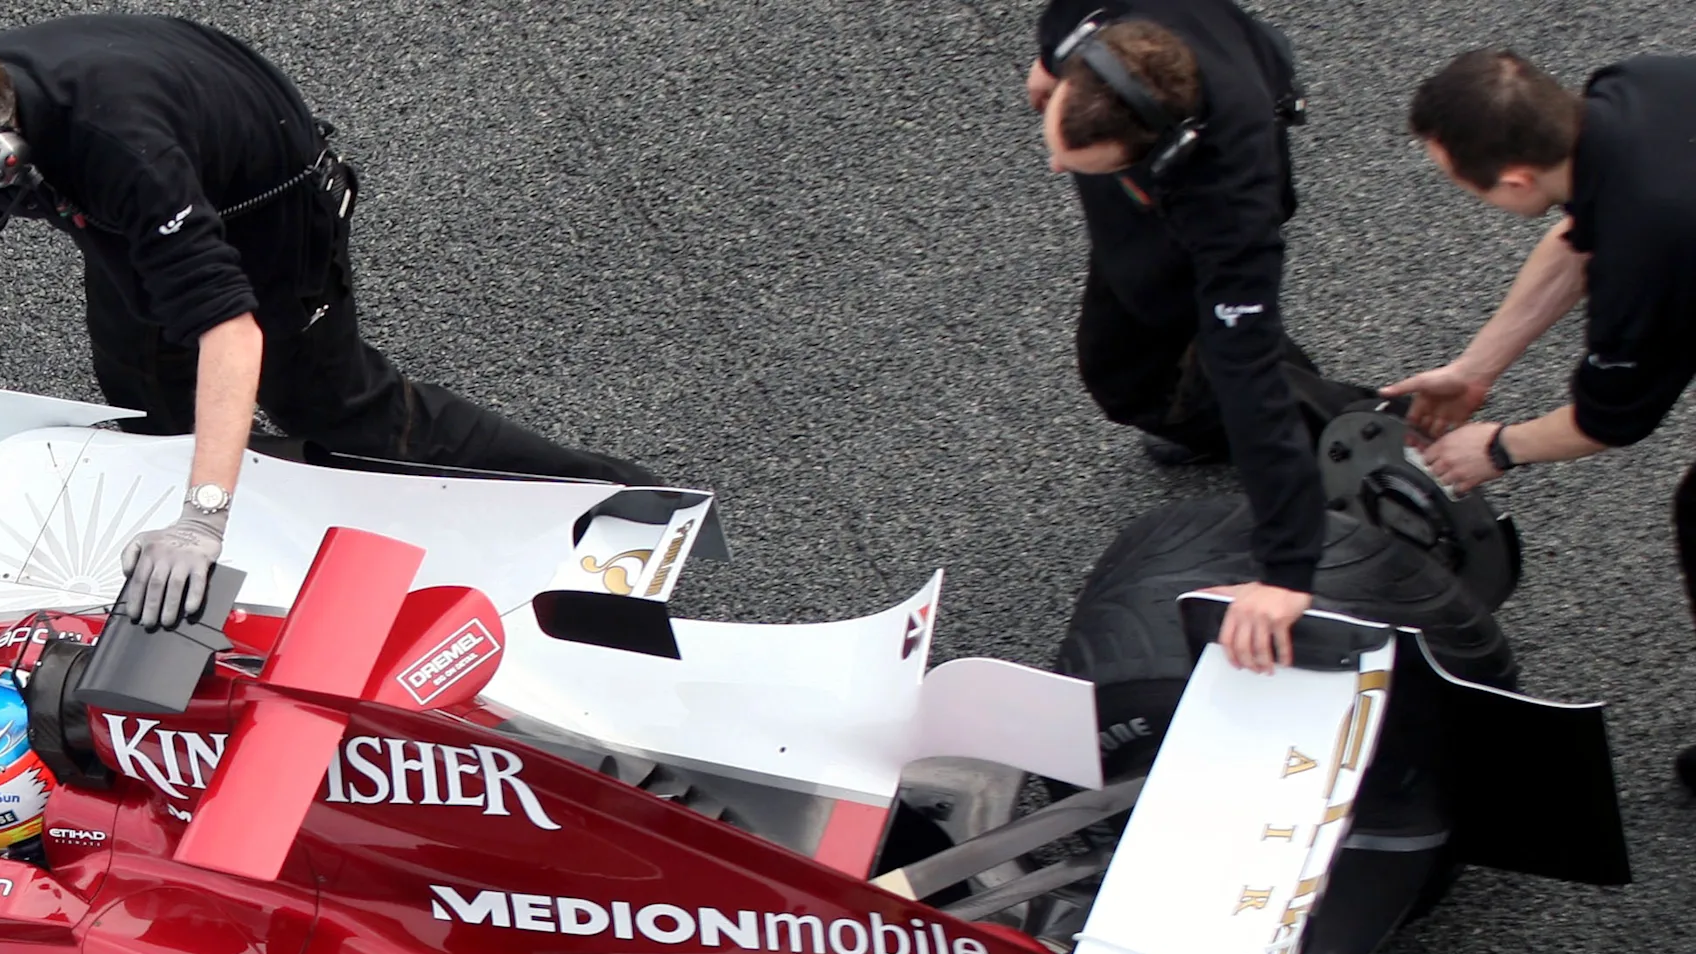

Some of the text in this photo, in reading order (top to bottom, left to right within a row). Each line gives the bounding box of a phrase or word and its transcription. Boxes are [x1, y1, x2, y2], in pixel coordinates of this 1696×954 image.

[408, 632, 485, 689] DREMEL
[103, 712, 562, 831] KINISHER
[49, 828, 107, 842] ETIHAD
